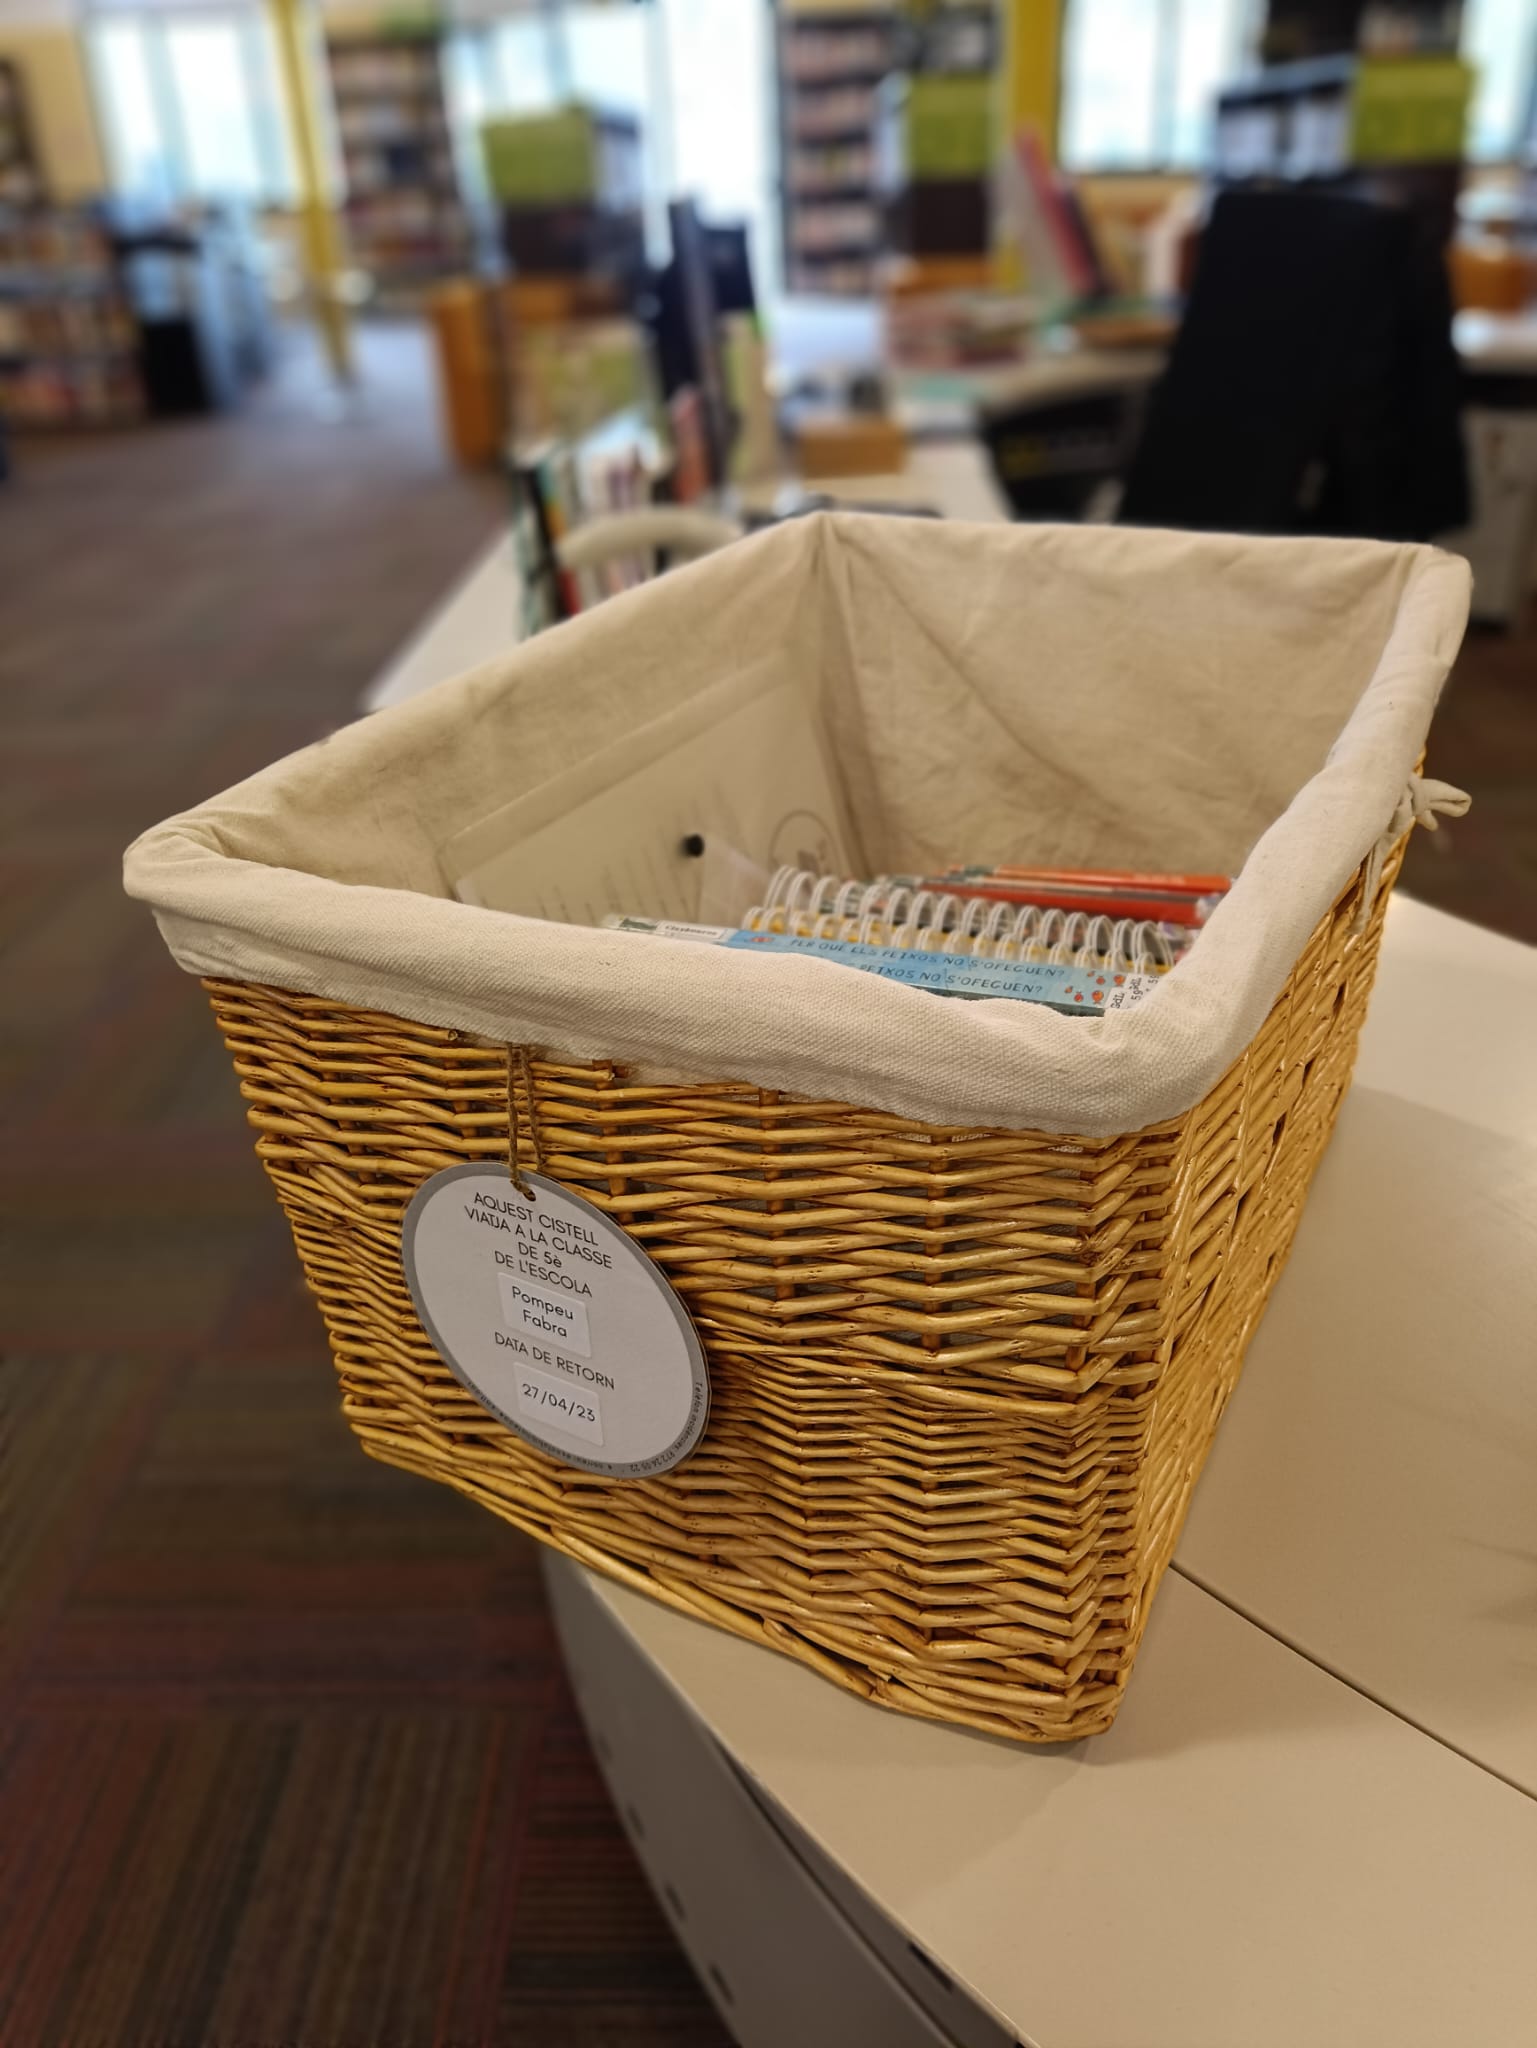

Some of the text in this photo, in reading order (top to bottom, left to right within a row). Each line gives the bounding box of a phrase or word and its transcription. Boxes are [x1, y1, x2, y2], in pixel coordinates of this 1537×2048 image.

[882, 949, 937, 963] PEIXOS
[943, 957, 965, 966] NO
[968, 960, 1065, 977] S'OFEGUEN?
[920, 971, 942, 982] NO
[946, 974, 1043, 993] S'OFEGUEN?
[464, 1205, 613, 1269] VIATJA A LA CLASSE
[474, 1192, 599, 1246] AQUEST CISTELL
[518, 1241, 562, 1268] DE 5è
[494, 1250, 592, 1298] DE L'ESCOLA
[511, 1285, 574, 1320] Pompeu
[522, 1309, 567, 1338] Fabra
[494, 1331, 615, 1391] DATA DE RETORN
[521, 1383, 596, 1422] 27/04/23
